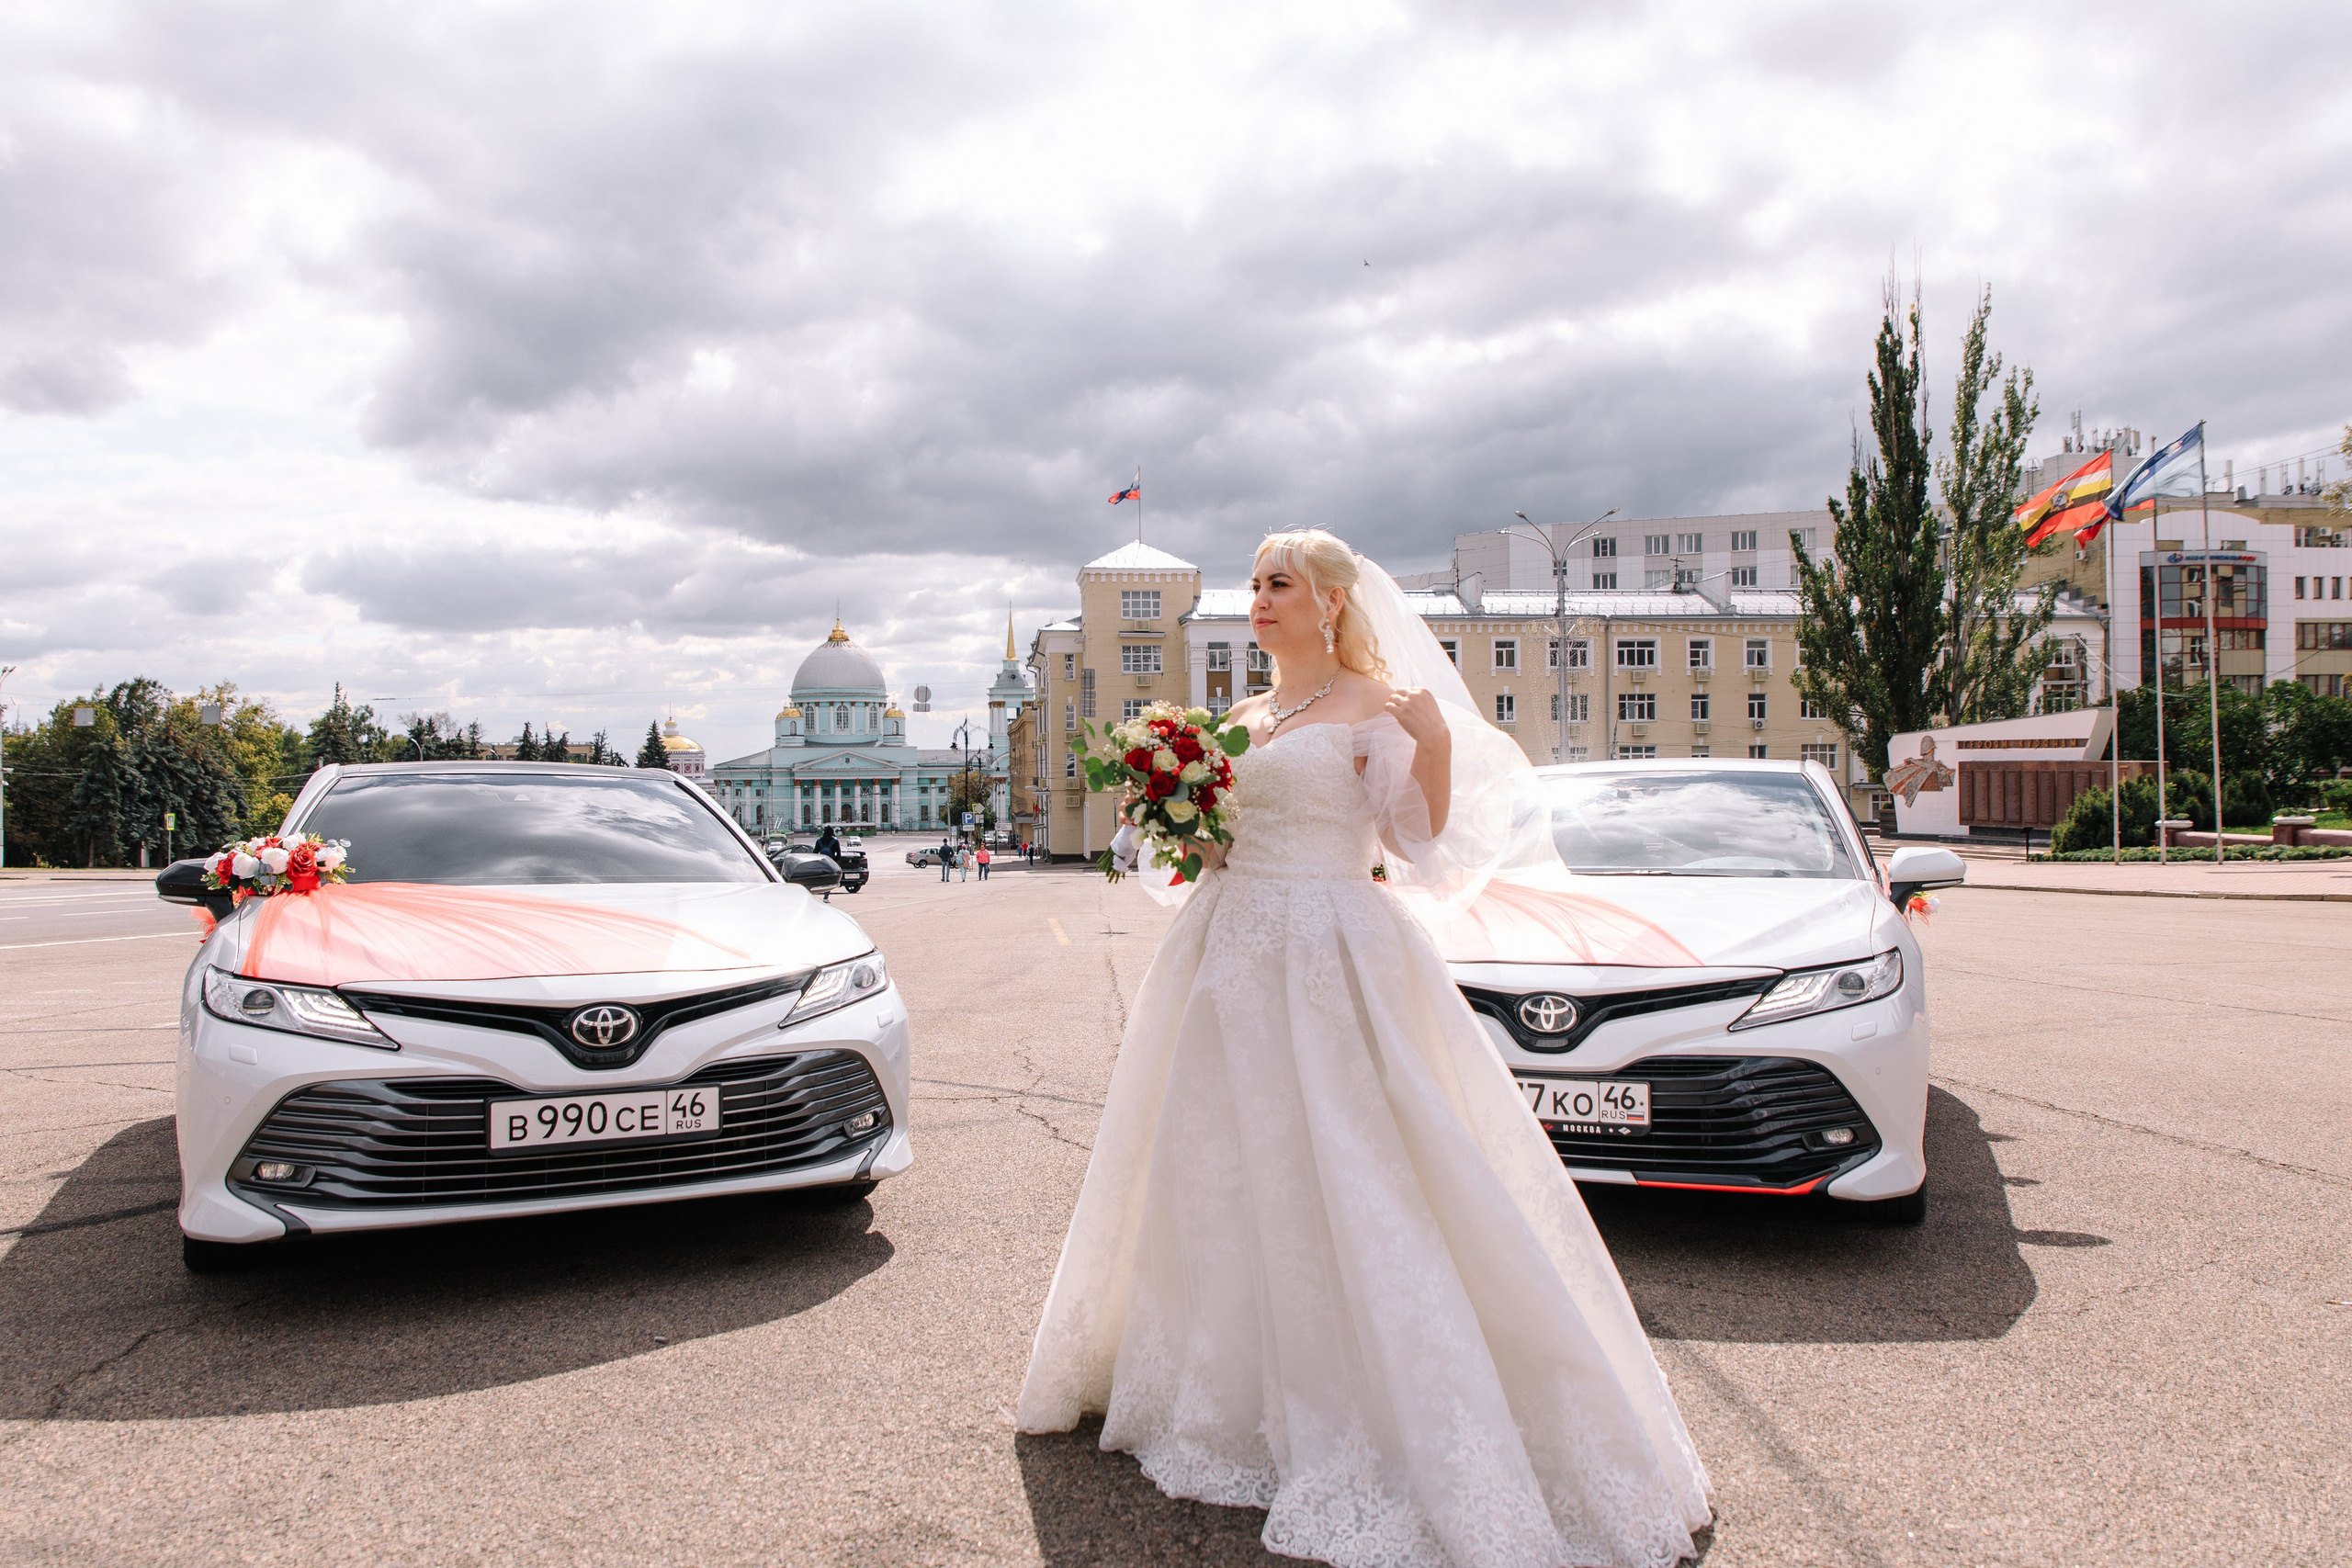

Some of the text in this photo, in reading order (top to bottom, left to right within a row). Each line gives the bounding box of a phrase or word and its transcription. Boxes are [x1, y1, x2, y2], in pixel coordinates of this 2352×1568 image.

[1516, 1082, 1635, 1116] 7КО 46
[672, 1092, 706, 1118] 46
[1601, 1111, 1625, 1120] RUS
[676, 1119, 702, 1130] RUS
[1563, 1124, 1600, 1134] МОСКВА
